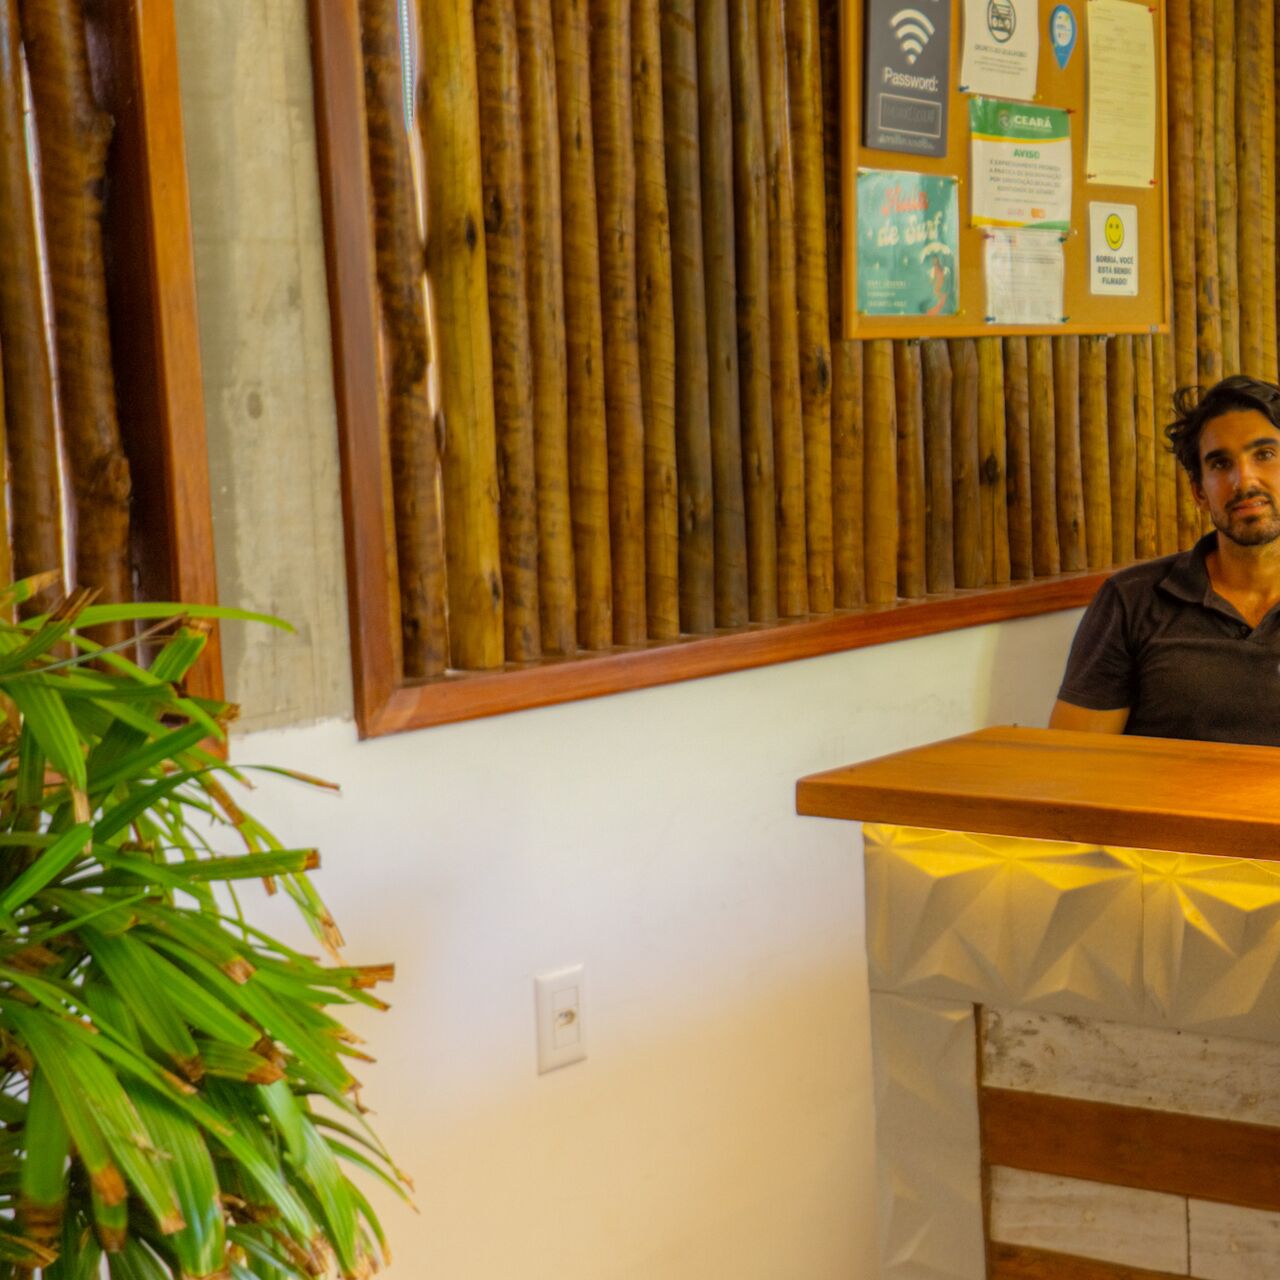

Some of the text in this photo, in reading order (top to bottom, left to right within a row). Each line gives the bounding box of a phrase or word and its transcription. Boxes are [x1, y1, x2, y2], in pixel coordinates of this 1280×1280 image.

[884, 67, 939, 92] Password:
[1013, 115, 1052, 128] CEARÁ
[1013, 149, 1040, 160] AVISO
